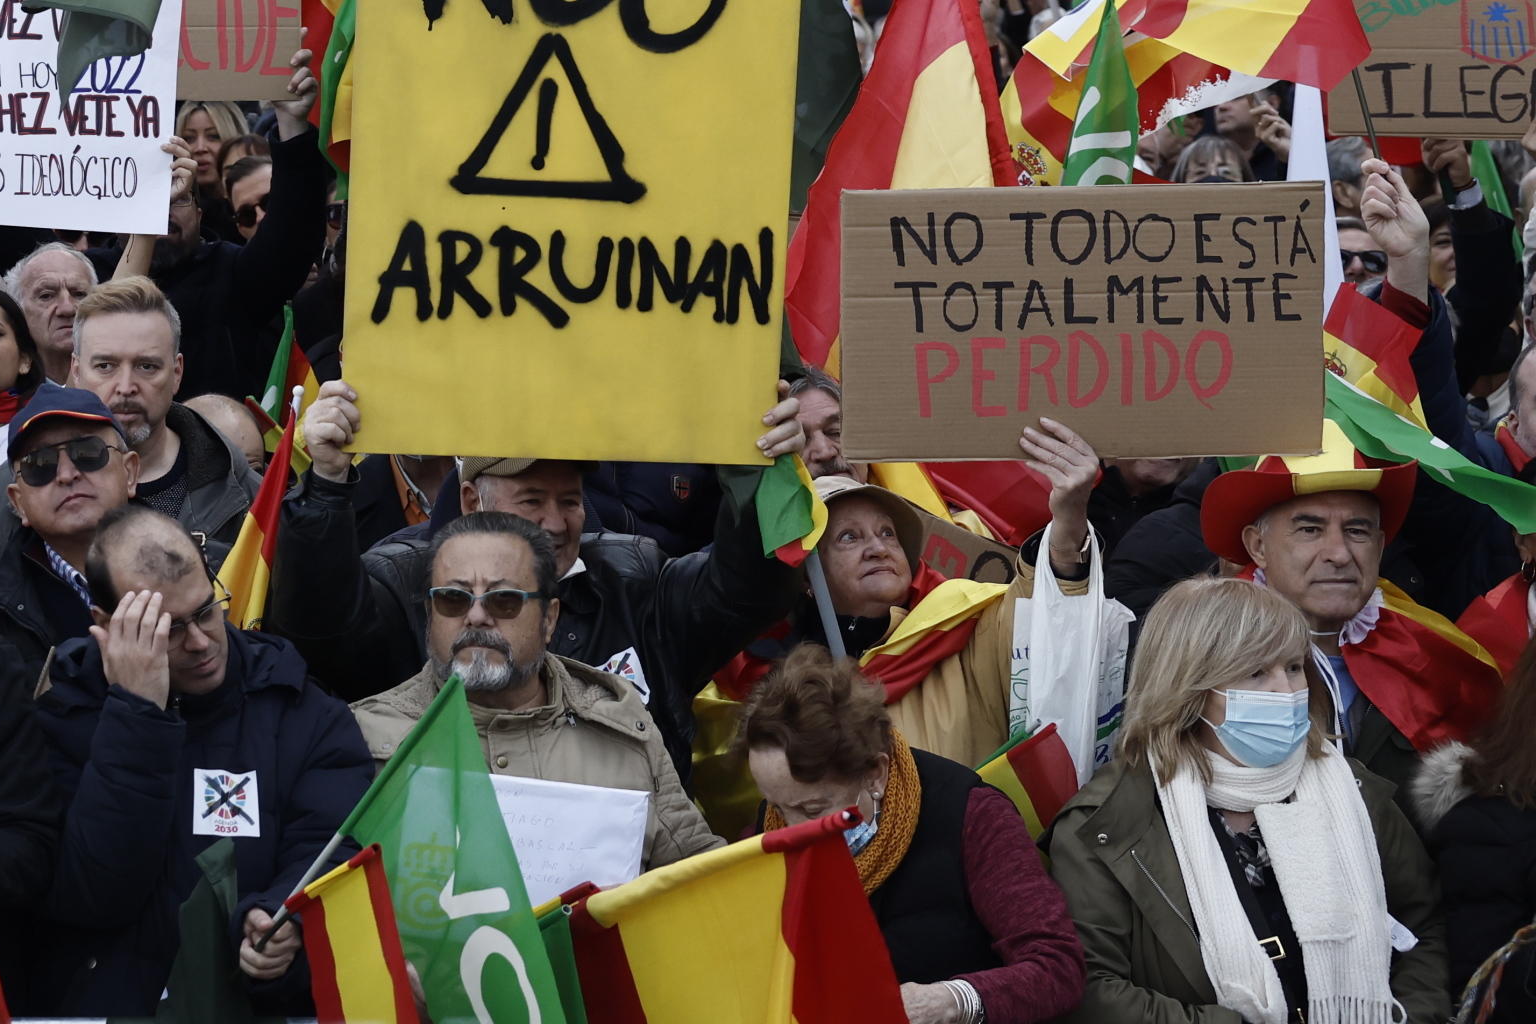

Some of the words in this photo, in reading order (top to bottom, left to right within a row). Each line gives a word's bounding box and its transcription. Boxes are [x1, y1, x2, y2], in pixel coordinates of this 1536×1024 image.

[19, 62, 59, 91] HOY
[1364, 62, 1536, 124] ILEG
[63, 94, 126, 137] VETE
[125, 94, 161, 139] YA
[13, 144, 138, 200] IDEOLÓGICO
[889, 209, 984, 267] NO
[1009, 208, 1176, 266] TODO
[1192, 199, 1317, 269] ESTÁ
[370, 220, 774, 330] ARRUINAN
[894, 272, 1302, 333] TOTALMENTE
[913, 328, 1234, 419] PERDIDO
[214, 824, 239, 833] 2030
